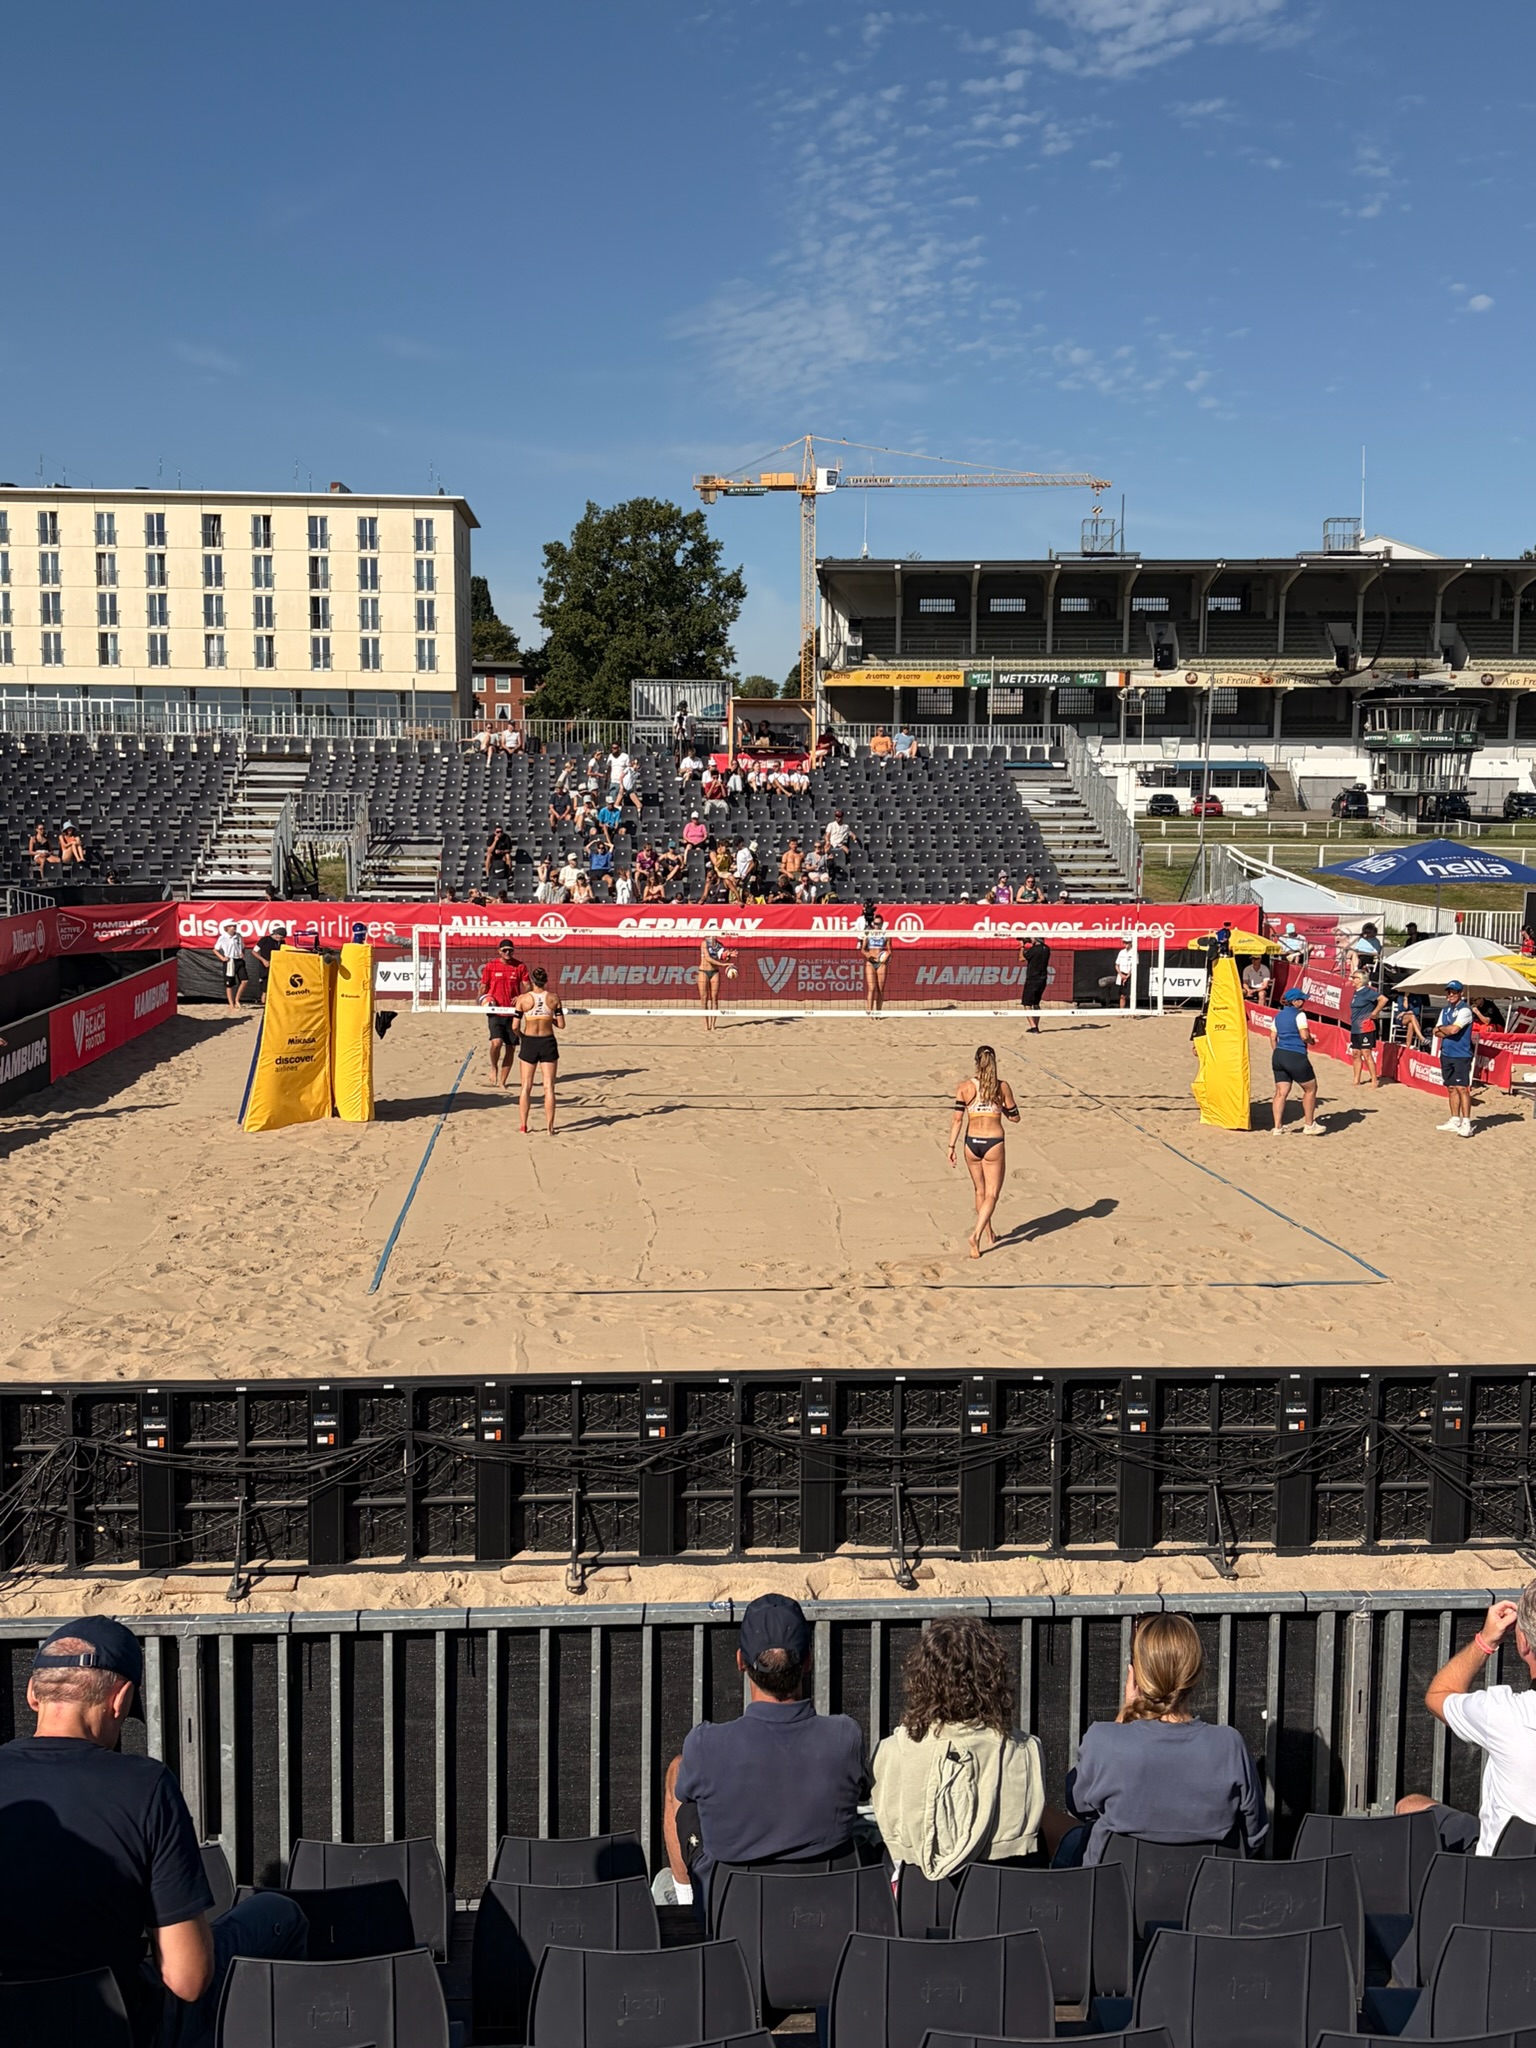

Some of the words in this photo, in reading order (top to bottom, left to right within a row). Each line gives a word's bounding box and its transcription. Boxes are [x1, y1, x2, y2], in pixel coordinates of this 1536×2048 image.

[999, 674, 1070, 684] WETTSTAR.de
[1205, 676, 1223, 684] Aus
[1226, 675, 1256, 684] Freude
[1502, 677, 1519, 685] Aus
[1417, 860, 1512, 876] hella
[60, 926, 80, 934] ACTIVE
[93, 919, 149, 929] HAMBURG
[179, 914, 297, 937] disover
[306, 915, 396, 938] airlies
[448, 916, 532, 937] Allianz
[617, 918, 763, 938] GERMANY
[811, 916, 889, 937] Alli
[94, 929, 132, 938] ACTIVE
[135, 926, 159, 935] CITY
[12, 927, 35, 955] Allianz
[560, 966, 699, 985] HAMBURG
[798, 965, 864, 980] BEACH
[798, 981, 826, 991] PRO
[828, 981, 864, 991] TOUR
[1169, 978, 1201, 986] VBTV
[286, 988, 310, 996] Senoh
[134, 981, 169, 1019] HAMBURG
[85, 1011, 106, 1036] BEACH
